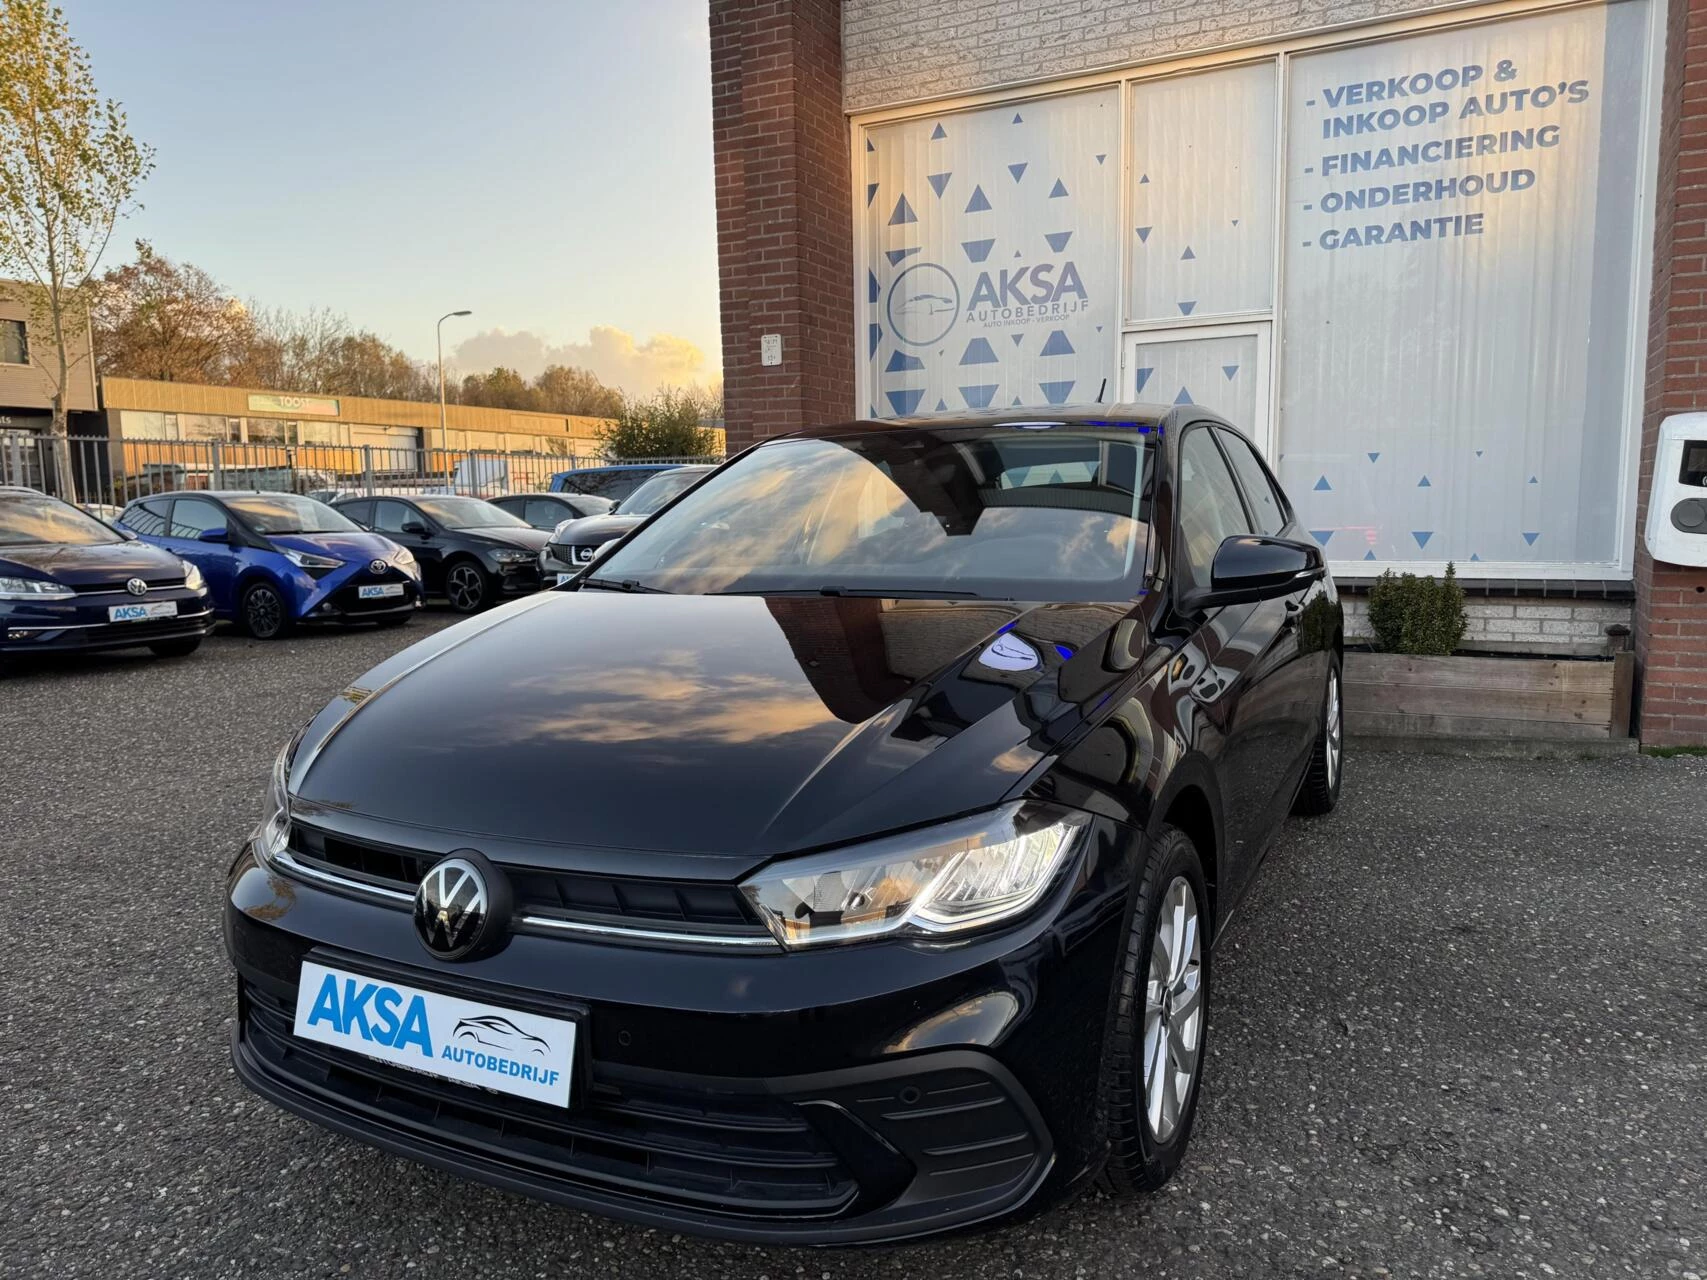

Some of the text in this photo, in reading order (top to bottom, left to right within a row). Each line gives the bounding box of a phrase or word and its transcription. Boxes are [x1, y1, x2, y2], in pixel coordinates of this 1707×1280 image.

[1322, 64, 1483, 109] VERKOOP
[1493, 59, 1517, 82] &
[1322, 79, 1590, 139] INKOOP AUTO'S
[1321, 124, 1561, 177] FINANCIERING
[1320, 168, 1536, 214] ONDERHOUD
[1319, 213, 1484, 250] GARANTIE
[967, 261, 1088, 312] AKSA
[966, 299, 1089, 324] AUTOBEDRIJF
[983, 320, 1001, 329] AUTO
[1003, 318, 1031, 326] INKOOP
[1036, 314, 1070, 324] VERKOOP
[114, 606, 148, 620] AKSA
[306, 973, 433, 1058] AKSA
[441, 1045, 560, 1086] AUTOBEDRIJF
